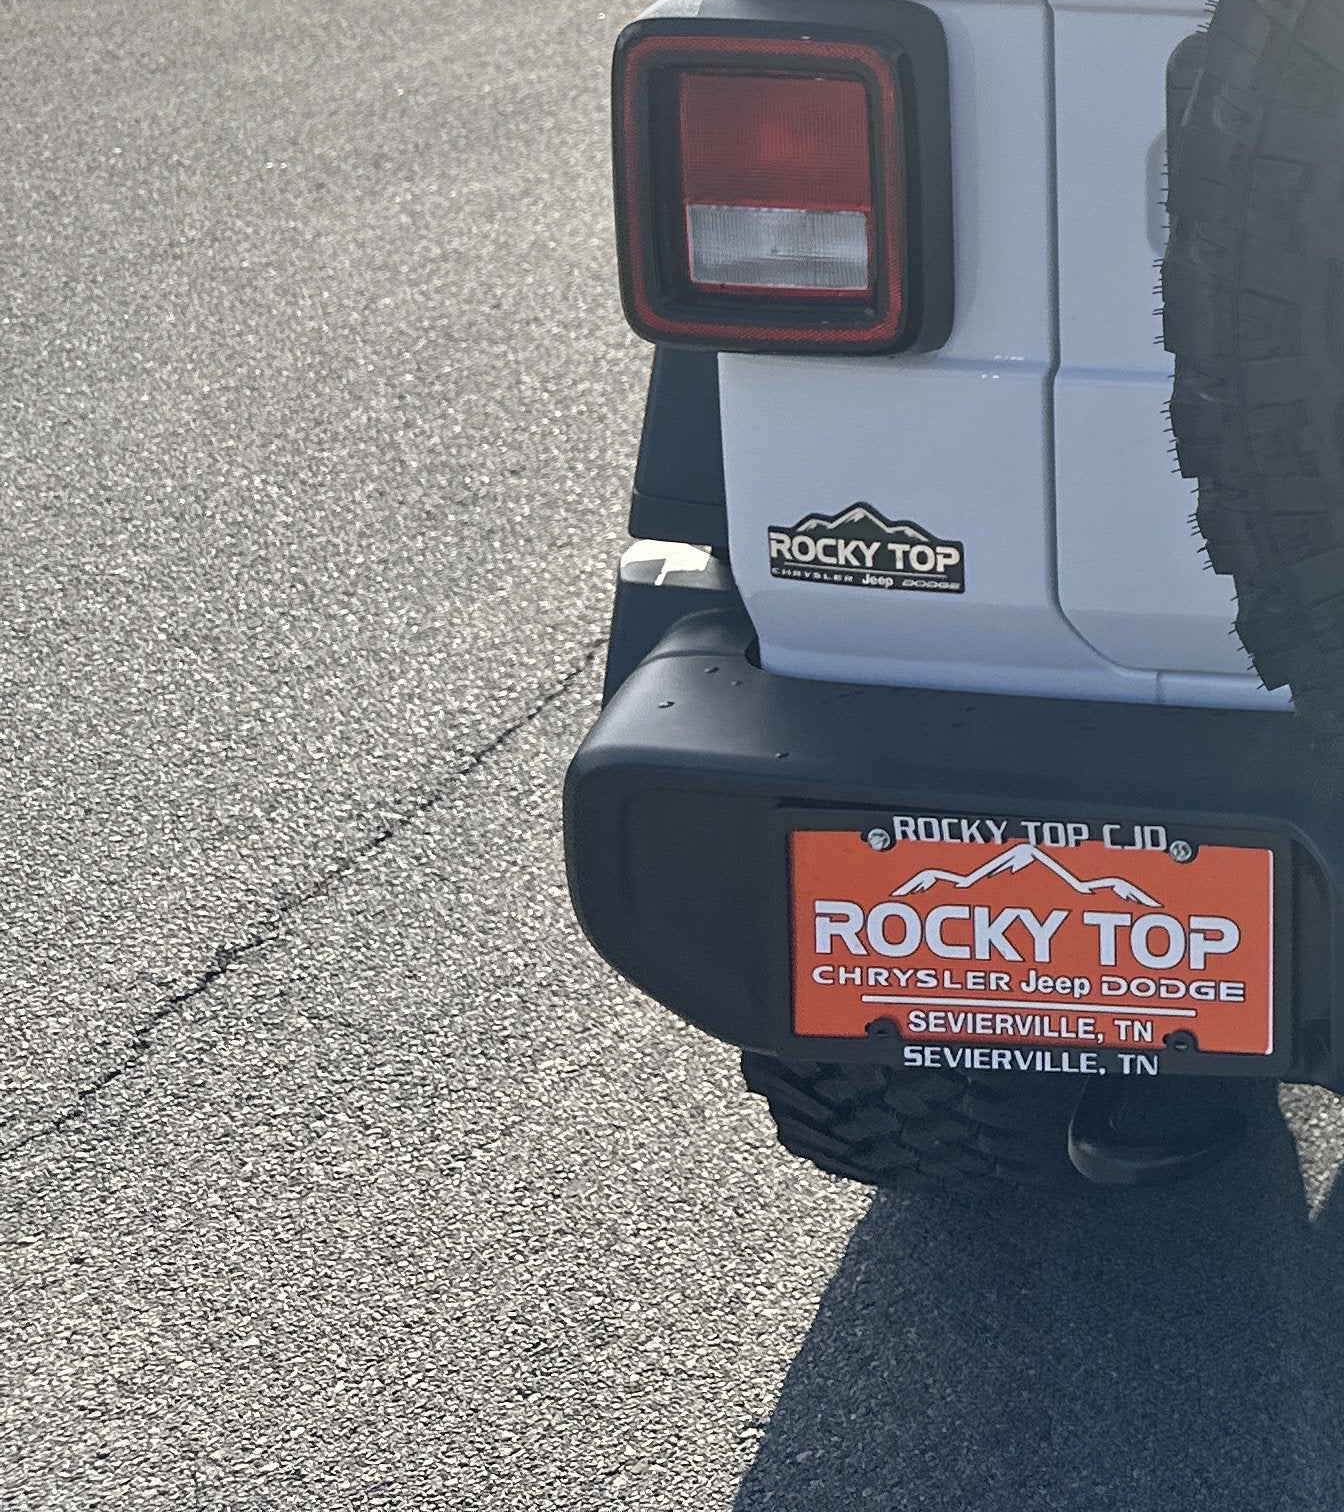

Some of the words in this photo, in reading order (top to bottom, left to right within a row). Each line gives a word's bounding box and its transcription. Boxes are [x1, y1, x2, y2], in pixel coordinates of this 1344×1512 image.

[769, 532, 881, 568] ROCKY
[888, 543, 961, 572] TOP
[772, 567, 853, 583] CHRYSLER
[862, 573, 894, 588] Jeep
[902, 578, 961, 590] DODGE
[893, 816, 1006, 846] ROCKY
[1021, 820, 1090, 849] TOP
[1103, 824, 1168, 852] CJD
[813, 899, 1069, 964] ROCKY
[1083, 910, 1241, 970] TOP
[811, 965, 1011, 992] CHRYSLER
[1021, 969, 1091, 999] Jeep
[1101, 975, 1246, 1003] DODGE
[908, 1010, 1105, 1044] SEVIERVILLE,
[1115, 1019, 1154, 1043] TN
[903, 1045, 1107, 1076] SEVIERVILLE,
[1118, 1052, 1160, 1077] TN
